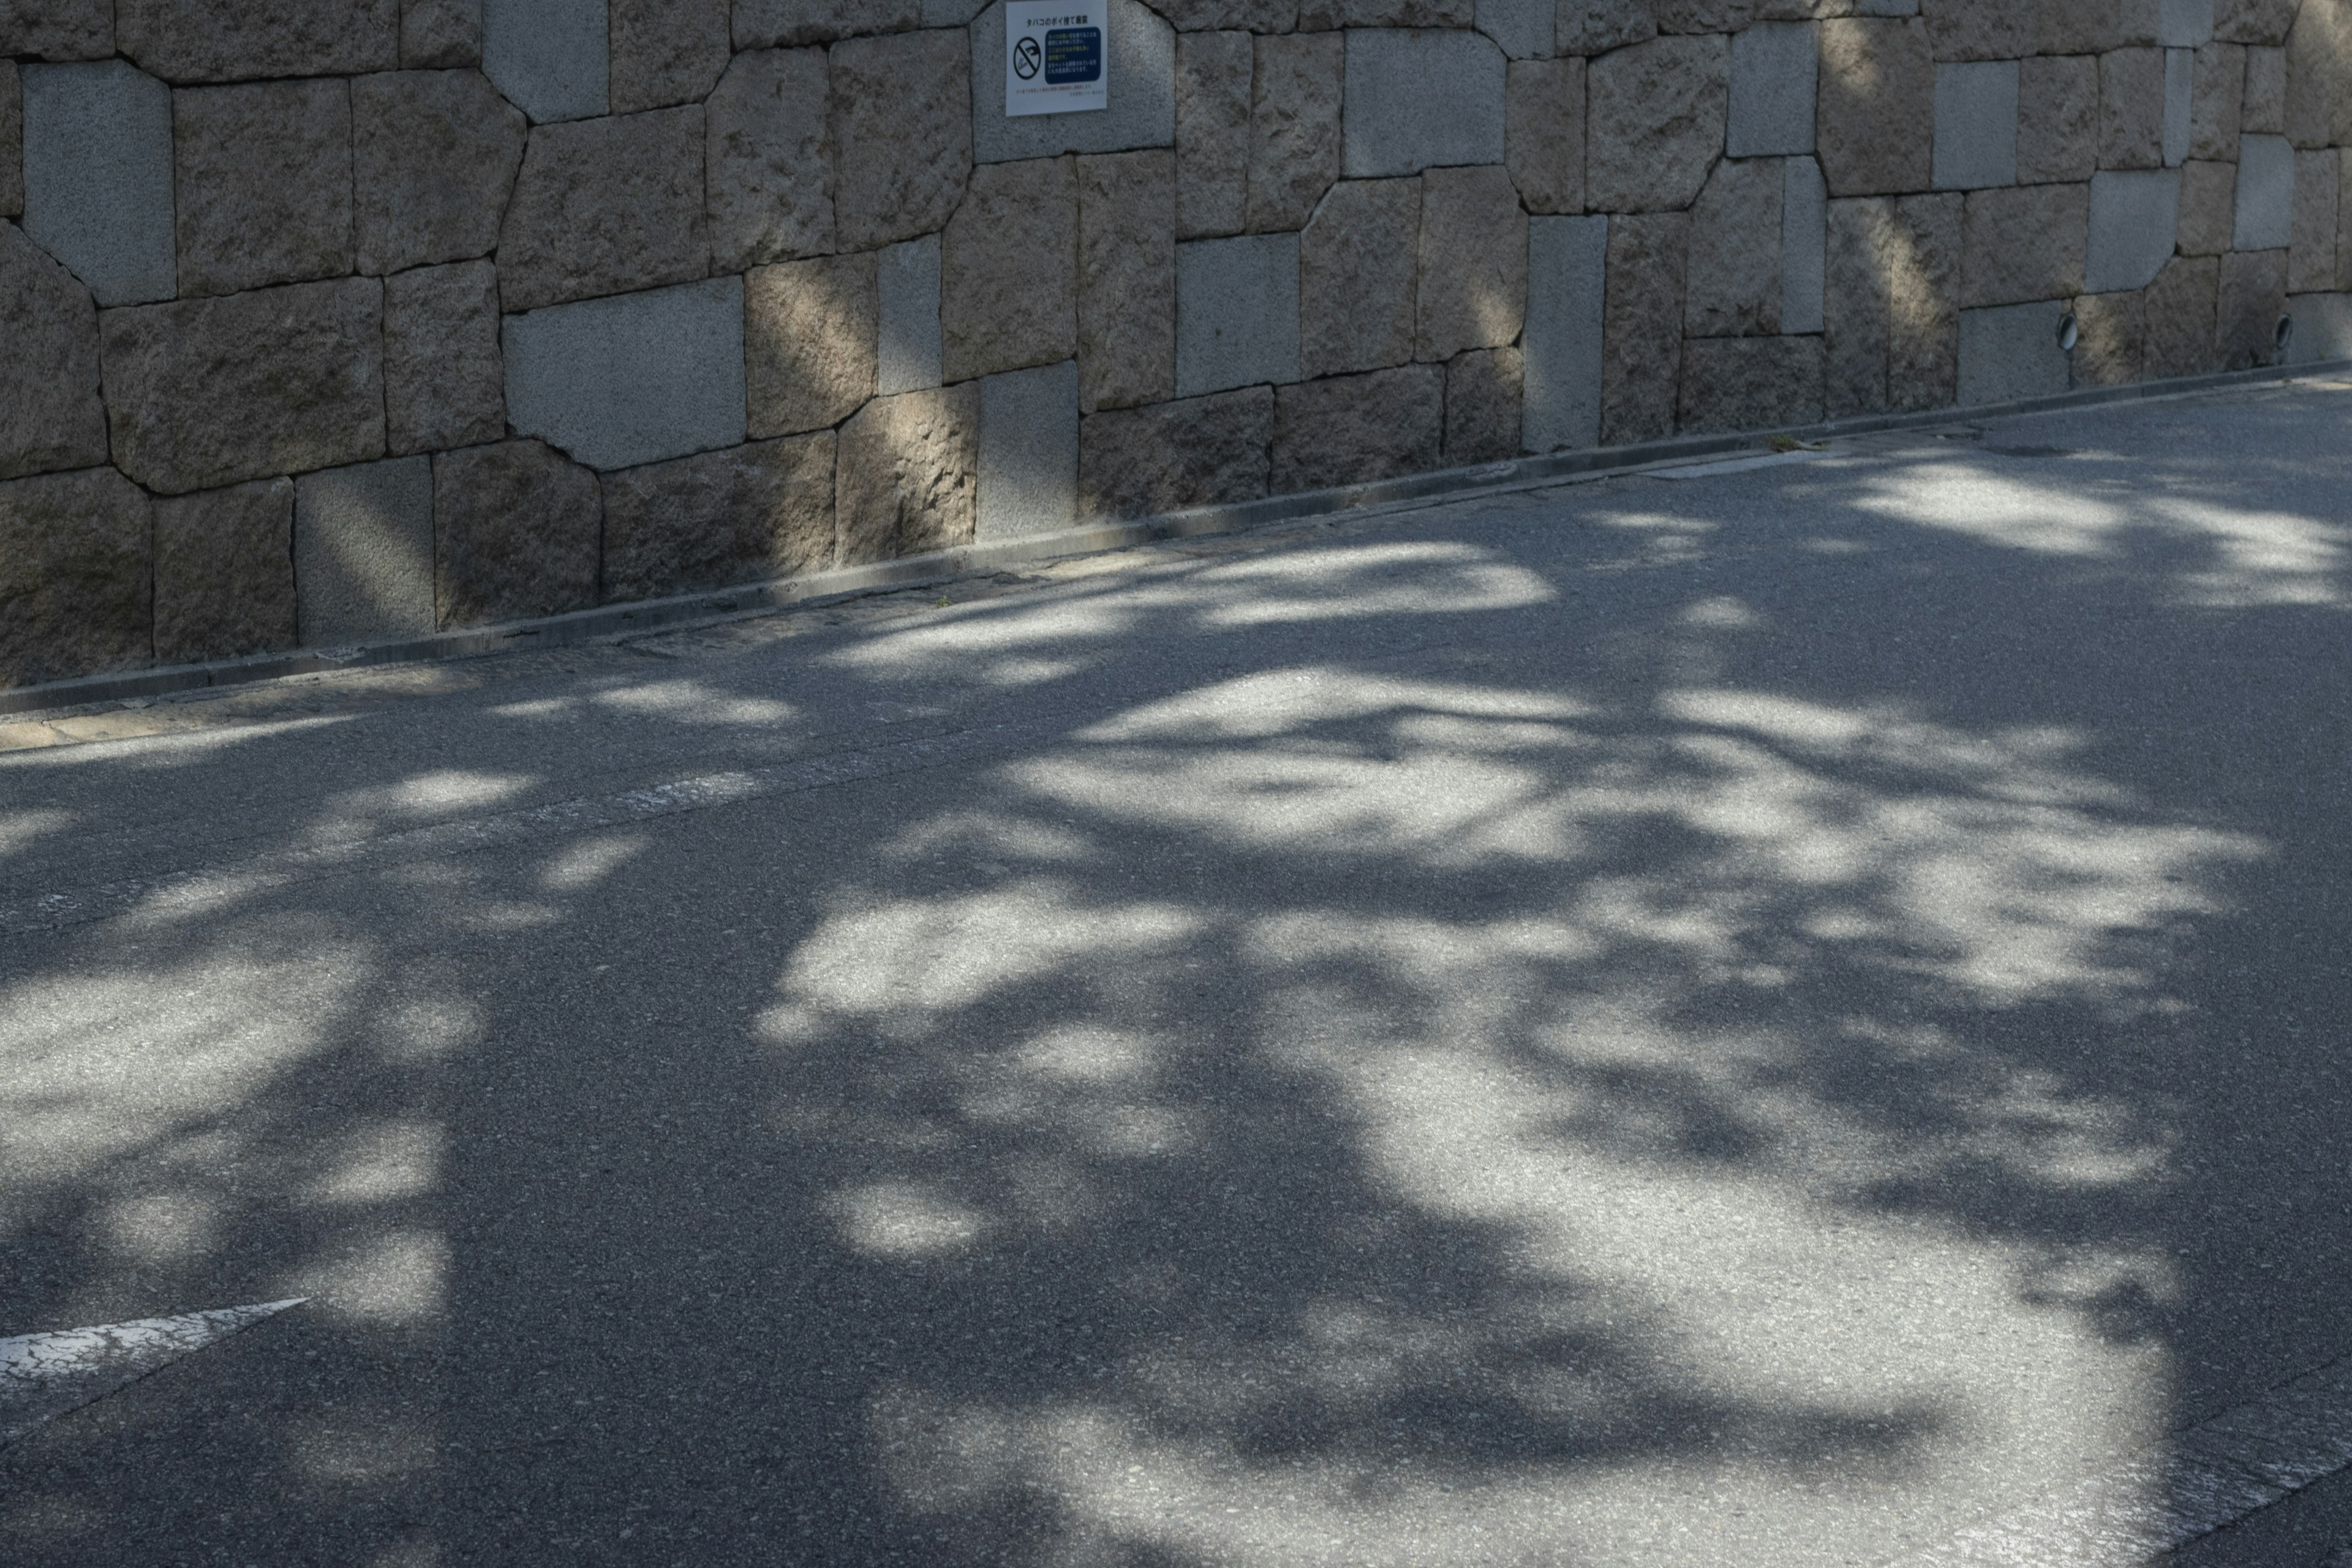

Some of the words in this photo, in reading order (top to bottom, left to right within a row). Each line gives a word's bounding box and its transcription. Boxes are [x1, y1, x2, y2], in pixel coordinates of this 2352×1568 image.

[1027, 15, 1088, 27] タバコのポイ捨て厳禁
